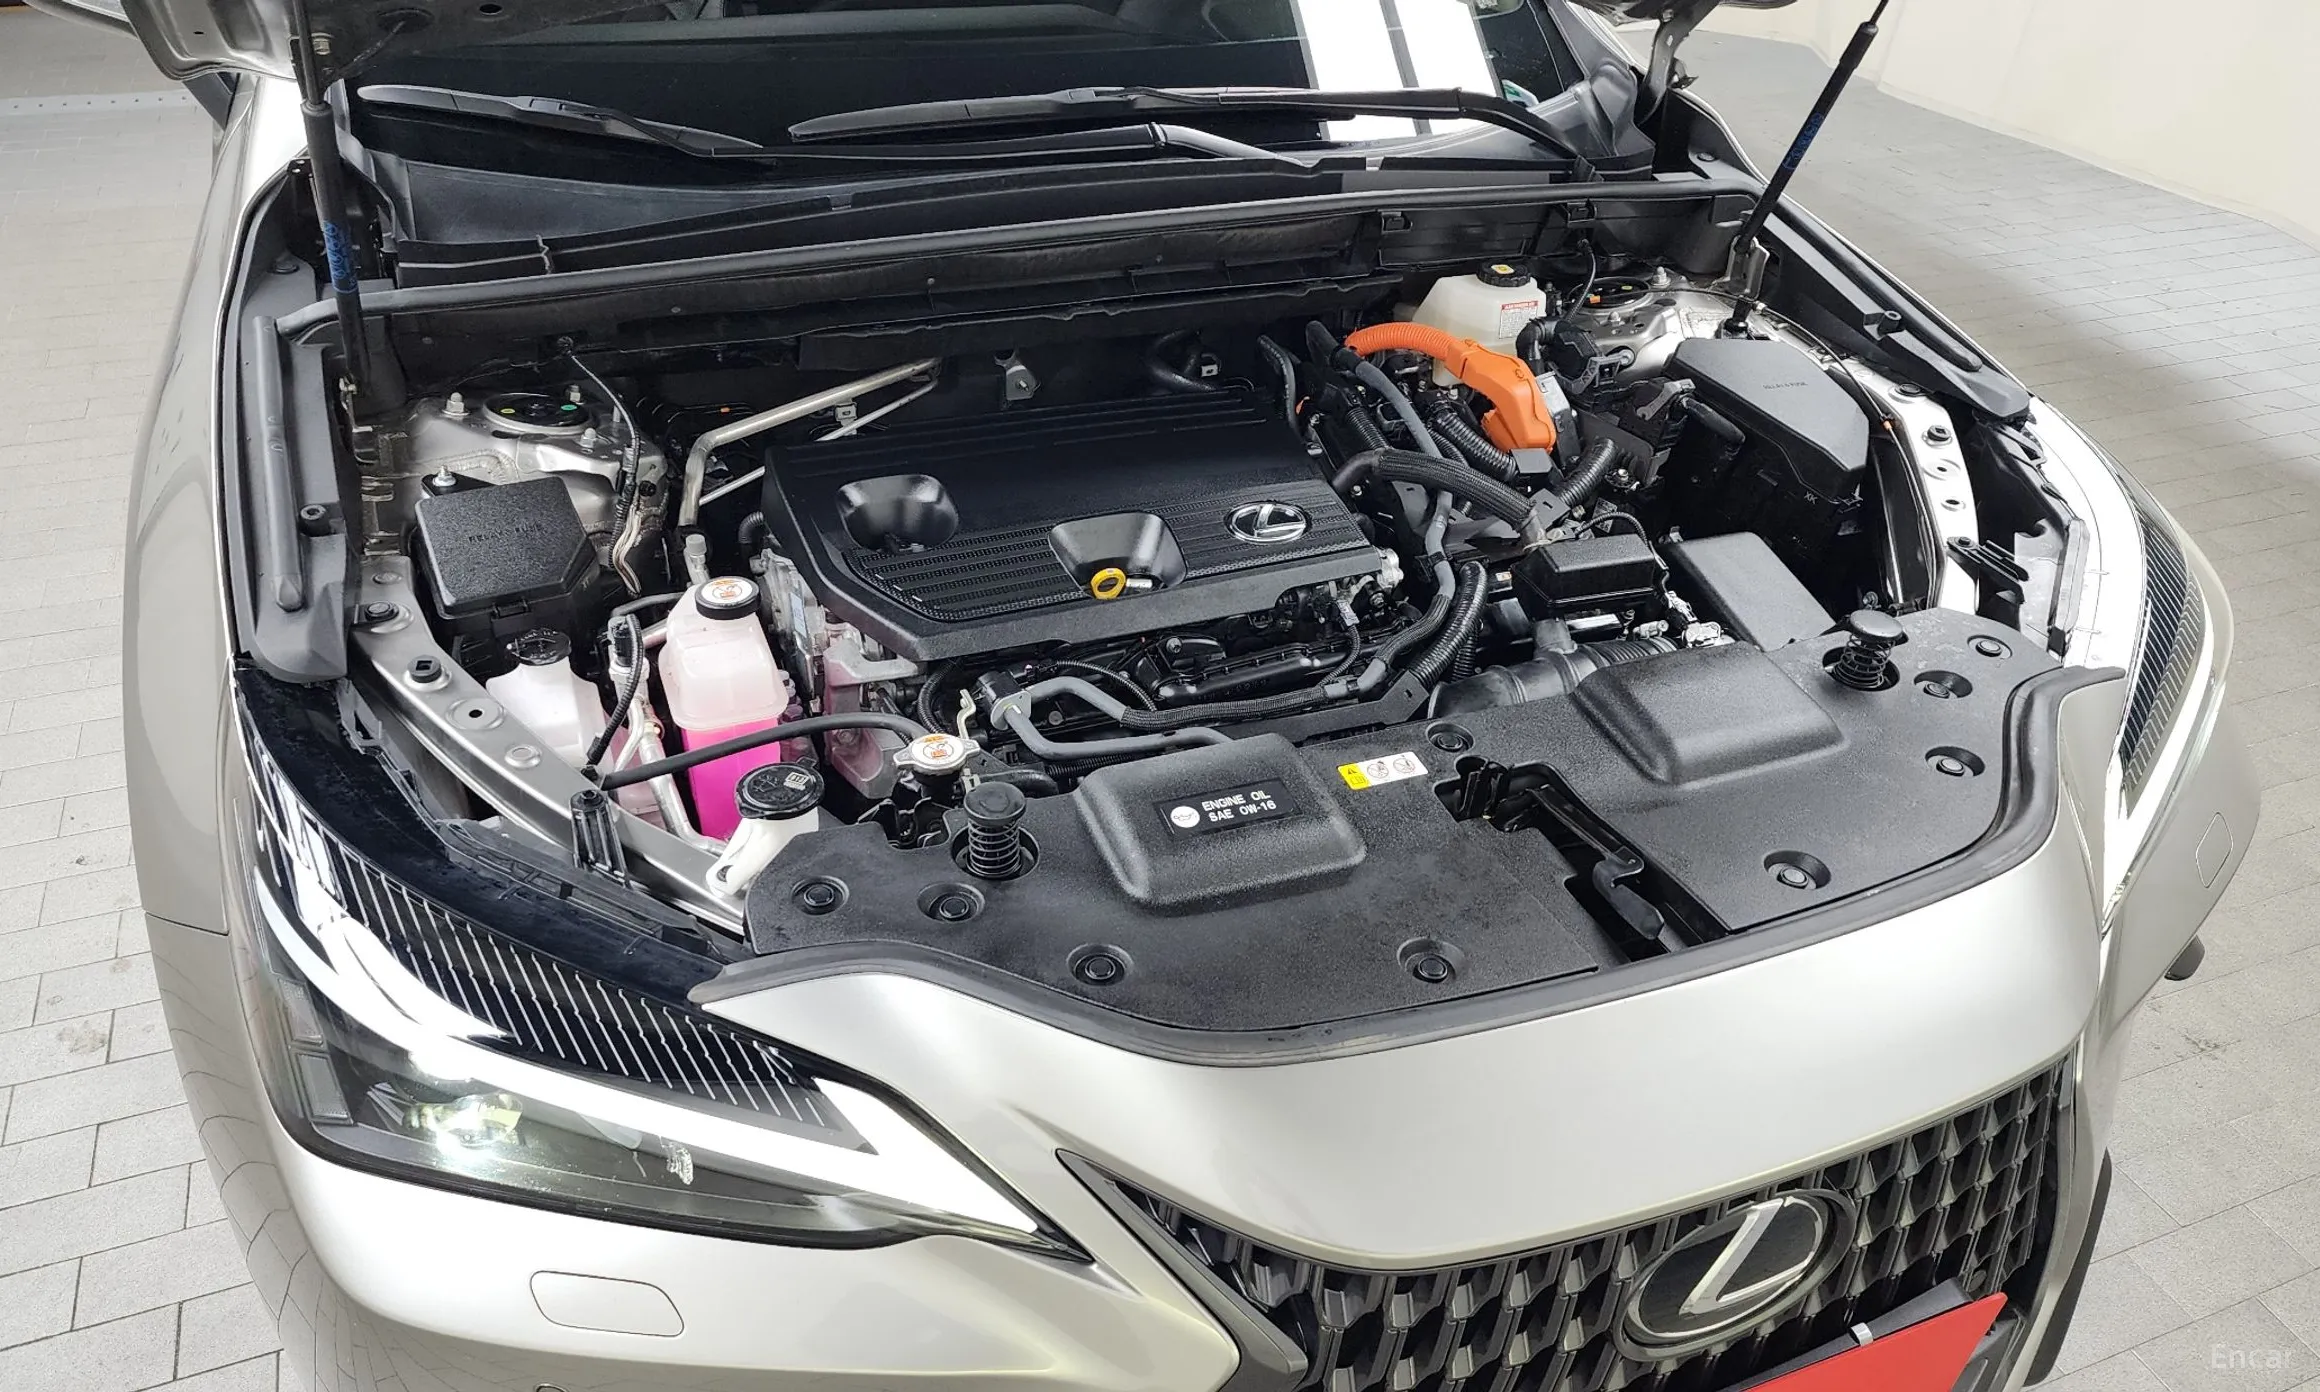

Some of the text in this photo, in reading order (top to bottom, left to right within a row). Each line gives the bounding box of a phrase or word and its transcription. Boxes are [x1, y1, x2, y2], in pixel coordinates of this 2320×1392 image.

[1201, 790, 1272, 812] ENGINE OIL
[1208, 800, 1277, 822] SAE 0W-16
